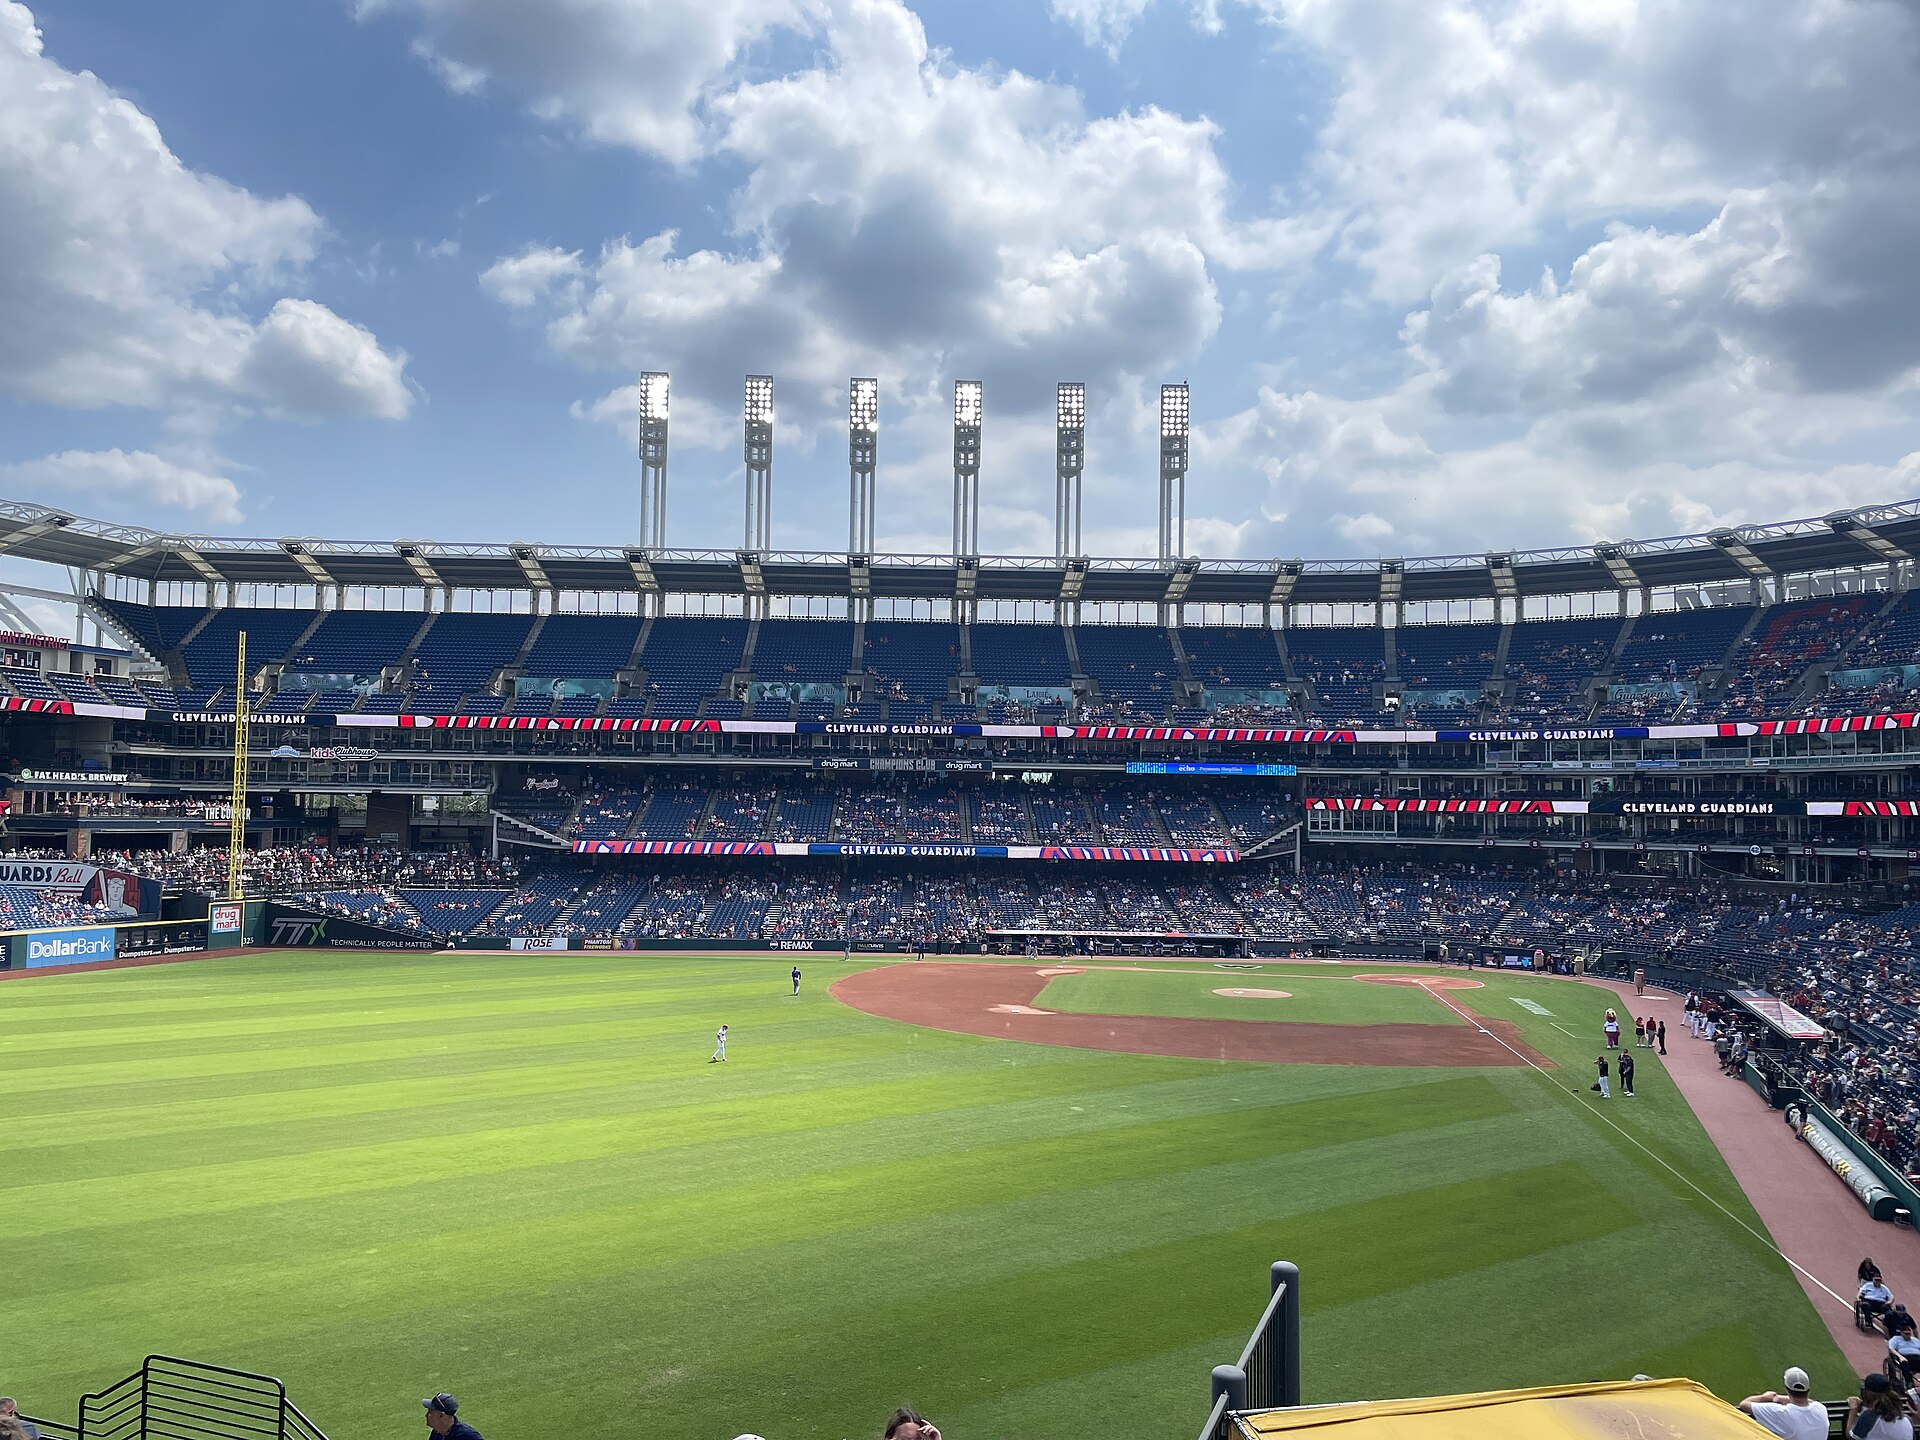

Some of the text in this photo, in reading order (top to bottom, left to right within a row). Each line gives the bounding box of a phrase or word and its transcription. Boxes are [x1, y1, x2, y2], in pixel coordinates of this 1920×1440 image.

[0, 630, 71, 650] ANT DISTRICT
[172, 712, 236, 723] CLEVELAND
[825, 723, 953, 735] CLEVELAND GUARDIANS
[1468, 729, 1614, 742] CLEVELAND GUARDIANS
[311, 747, 335, 758] kids
[821, 759, 858, 768] drug mart
[869, 758, 936, 770] CHAMPIONS CLUB
[945, 760, 983, 771] drug mart
[34, 771, 128, 782] FAT HEAD'S BREWERY
[205, 807, 219, 820] THE
[1622, 803, 1774, 814] CLEVELAND GUARDIANS
[840, 845, 977, 857] CLEVELAND GUARDIANS
[53, 867, 84, 883] Ball
[214, 908, 240, 929] drug mart
[243, 937, 254, 945] 325
[331, 939, 432, 949] TECHNICALLY, PEOPLE MATTER
[524, 938, 553, 950] ROSE
